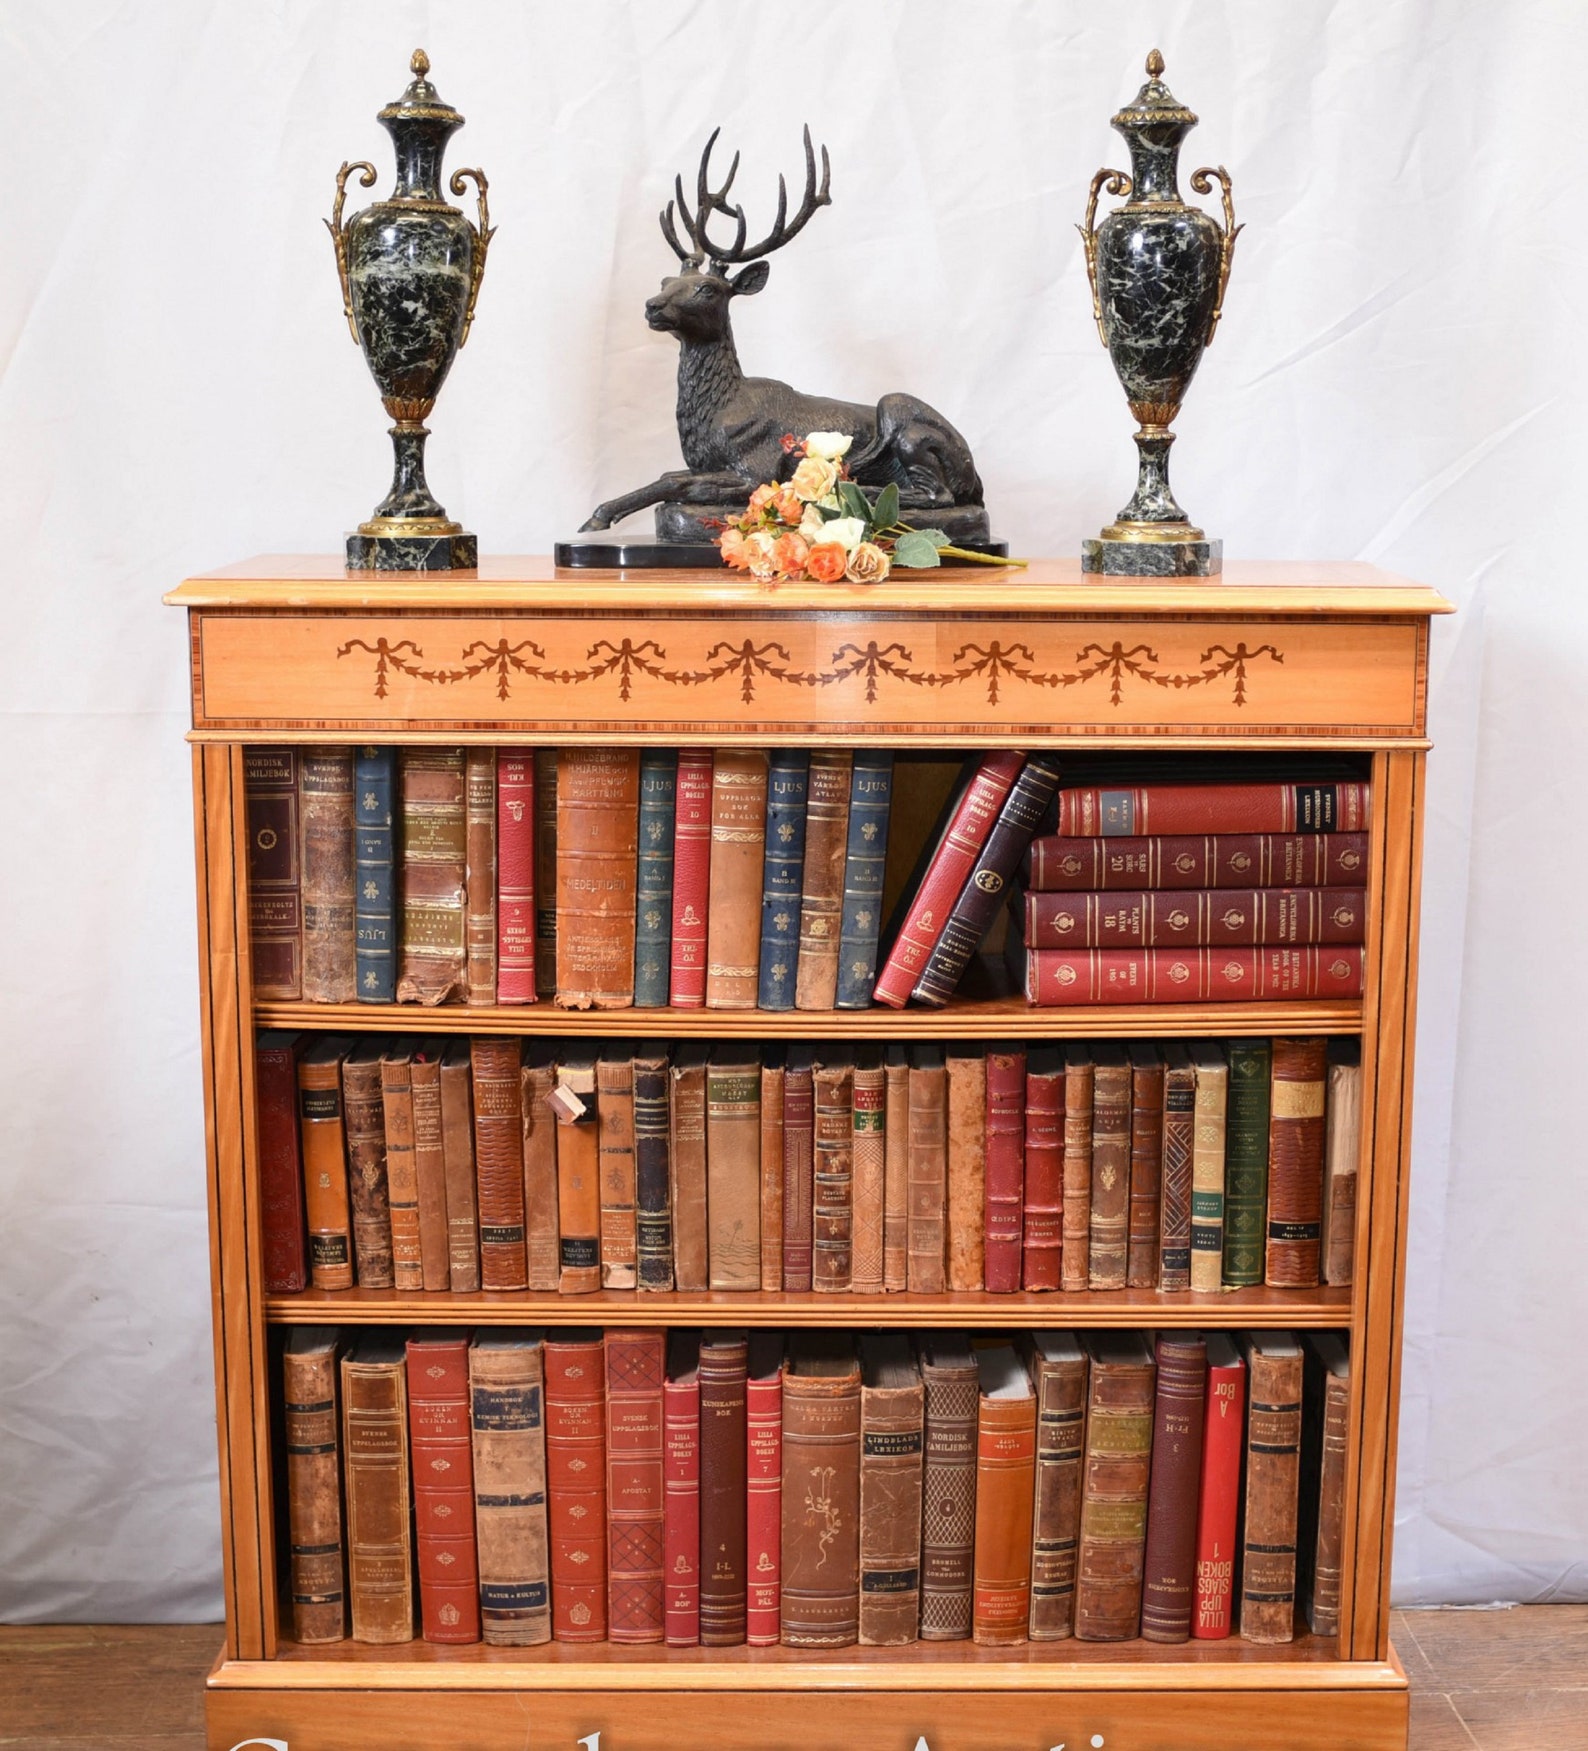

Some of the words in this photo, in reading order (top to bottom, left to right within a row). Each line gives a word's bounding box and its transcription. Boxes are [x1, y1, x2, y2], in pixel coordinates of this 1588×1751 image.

[247, 759, 284, 767] NORDISK
[247, 769, 290, 778] MILJEBOK
[643, 780, 672, 792] LJUS
[774, 781, 804, 794] LJUS
[858, 780, 888, 793] LJUS
[1112, 856, 1124, 872] 20
[567, 880, 626, 890] MEDELTIDEN
[1104, 914, 1117, 928] 18
[1118, 910, 1126, 932] RAYM
[1132, 907, 1140, 934] PLANTS
[1279, 898, 1287, 938] BRITANNICA
[358, 929, 386, 940] LJUS
[702, 1400, 744, 1408] KUNSKAPENS
[1220, 1400, 1228, 1418] A
[867, 1434, 918, 1444] LINDBLADS
[932, 1432, 968, 1441] NORDISK
[874, 1444, 914, 1452] LEXIKON
[926, 1441, 973, 1452] FAMILJEBOK
[1172, 1444, 1180, 1452] 3
[672, 1450, 692, 1458] BOKEN
[720, 1544, 726, 1552] 4
[1214, 1542, 1220, 1559] 1
[716, 1562, 732, 1571] I-L
[1197, 1560, 1232, 1578] BOKEN
[1198, 1578, 1230, 1594] SLAGS
[516, 1590, 541, 1598] KULTUR
[1200, 1594, 1222, 1611] UPP
[1198, 1610, 1224, 1628] LILLA
